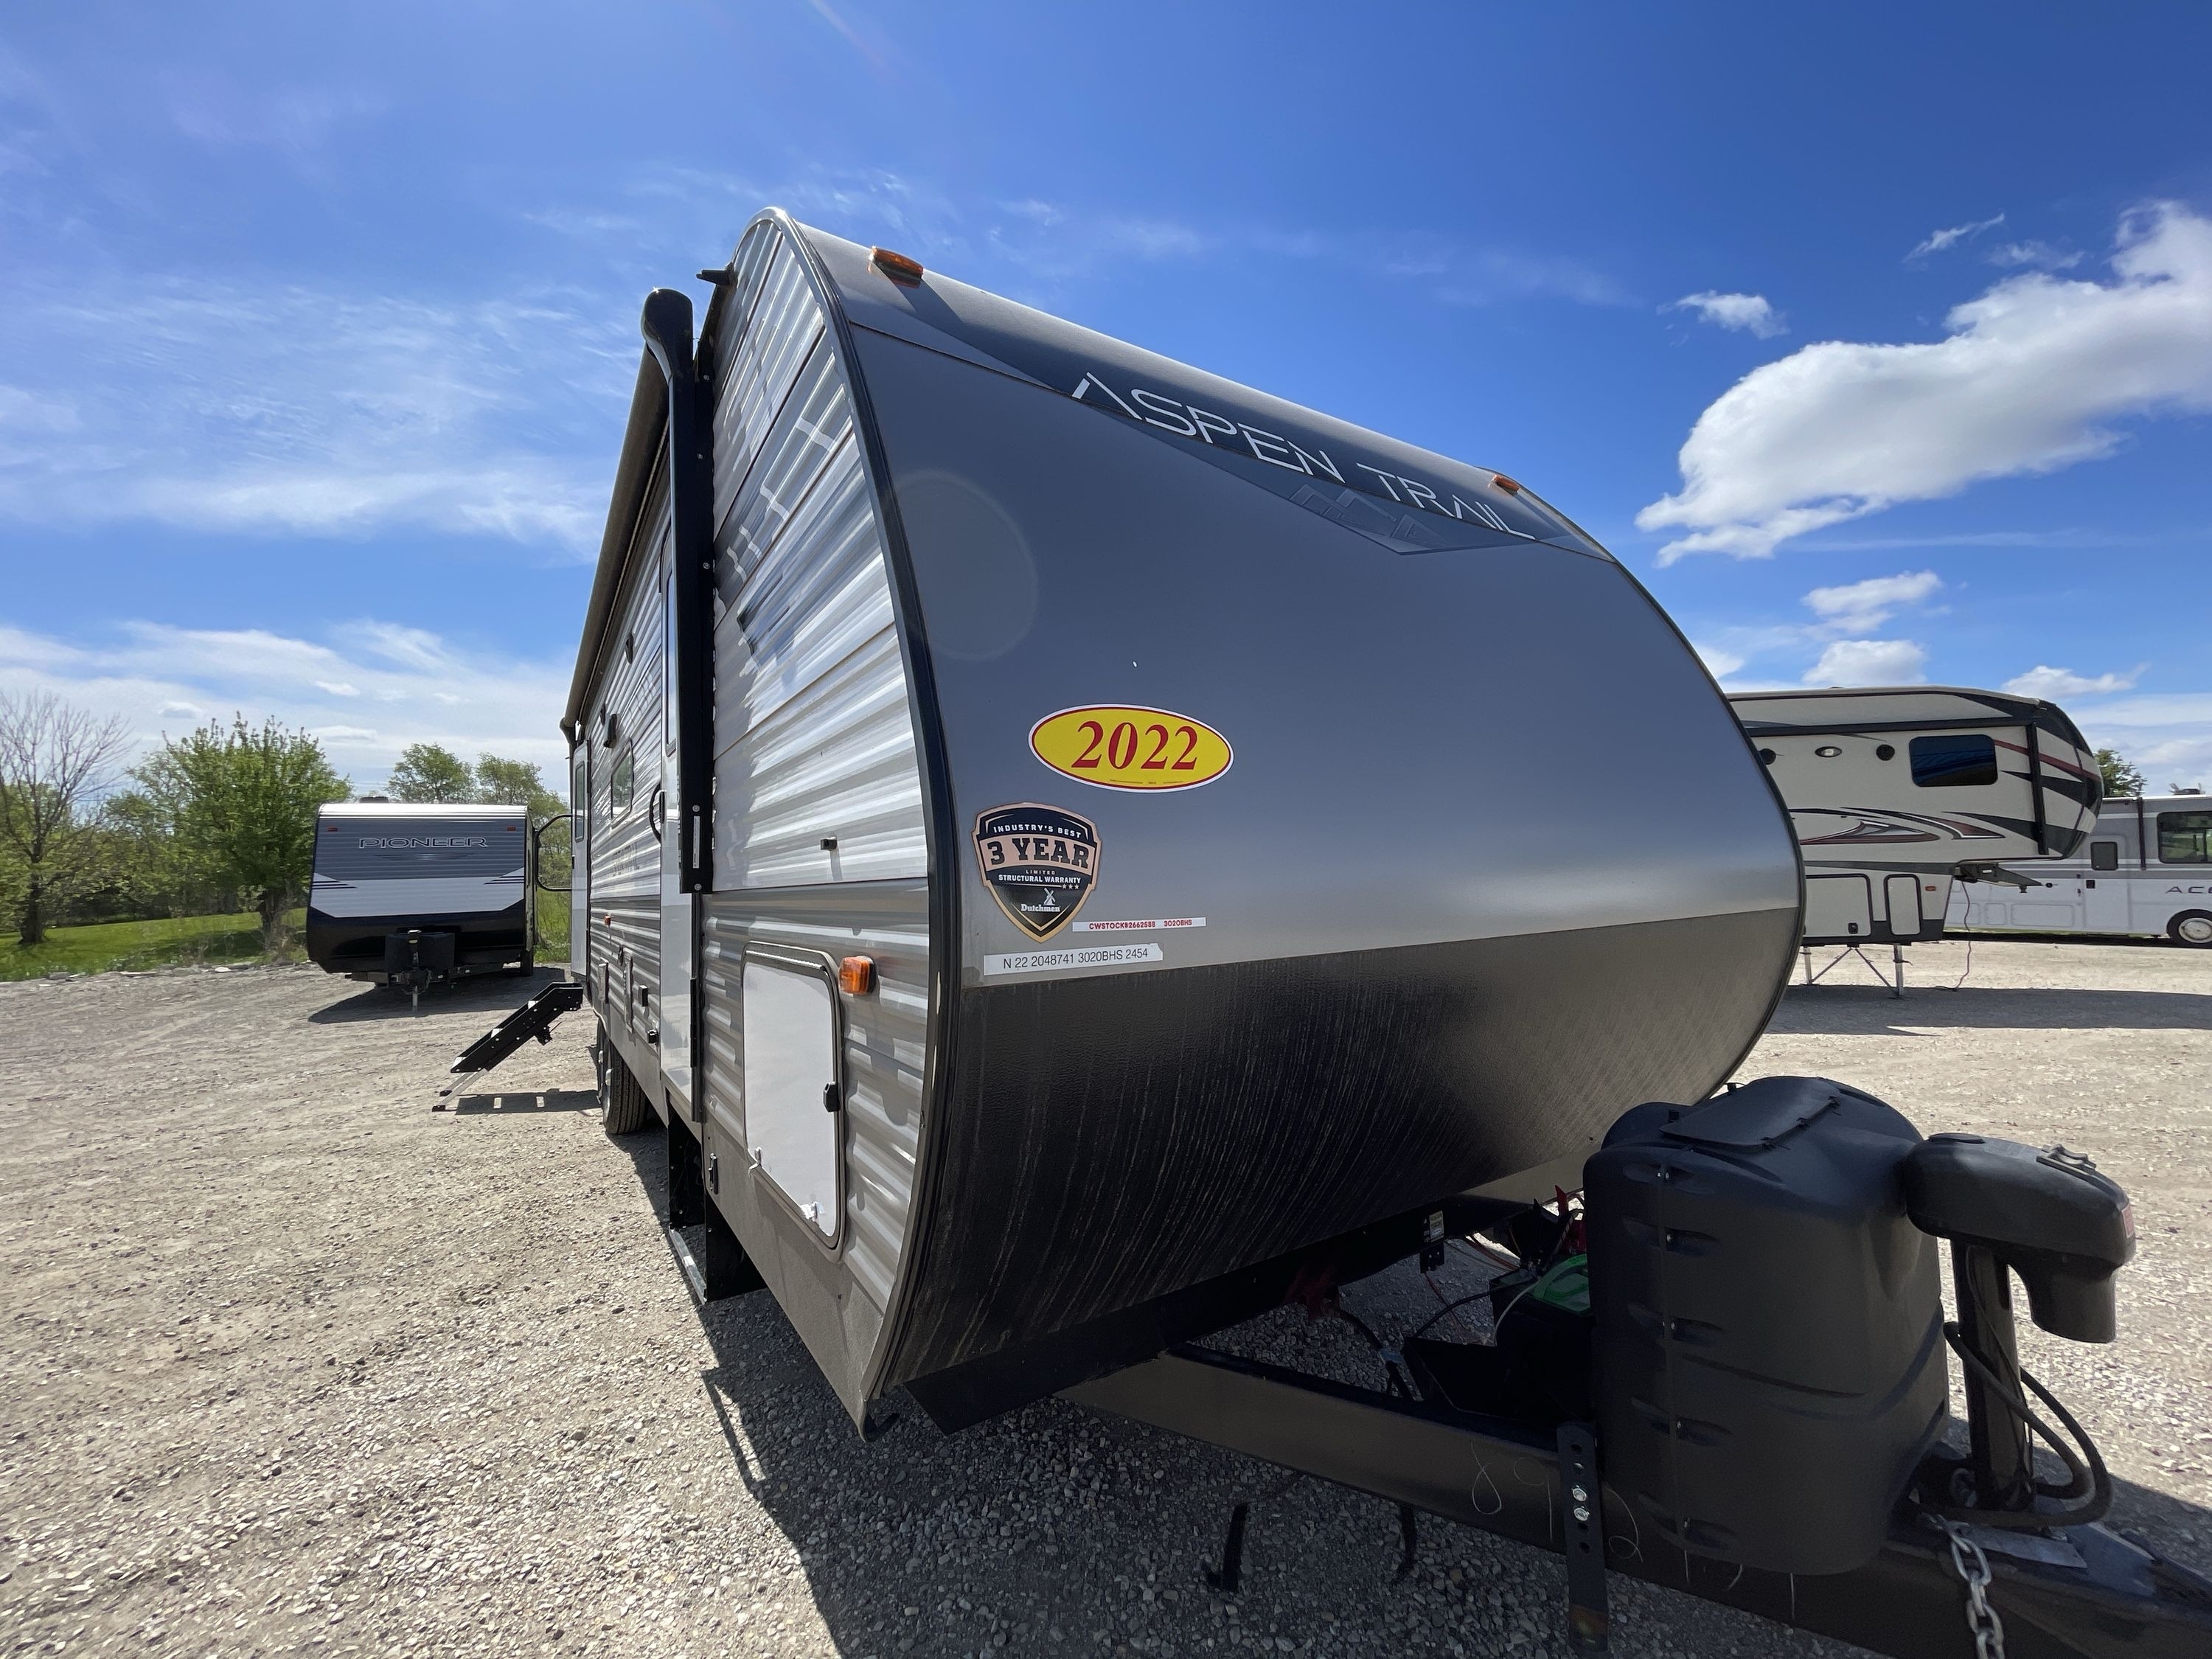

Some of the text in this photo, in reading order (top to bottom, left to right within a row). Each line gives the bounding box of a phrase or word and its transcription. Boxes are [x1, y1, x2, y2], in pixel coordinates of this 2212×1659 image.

[1071, 372, 1536, 540] ASPEN TRAIL
[1071, 720, 1197, 771] 2022
[993, 824, 1082, 838] INDUSTRY'S BEST
[359, 837, 489, 849] PIONEER
[987, 837, 1089, 869] 3 YEAR
[998, 874, 1081, 884] STRUCTURAL WARRANTY
[1020, 903, 1060, 912] Dutchmen
[1164, 919, 1192, 927] 3020BHS
[1003, 948, 1148, 969] N 22 2048741 3020BHS 2454
